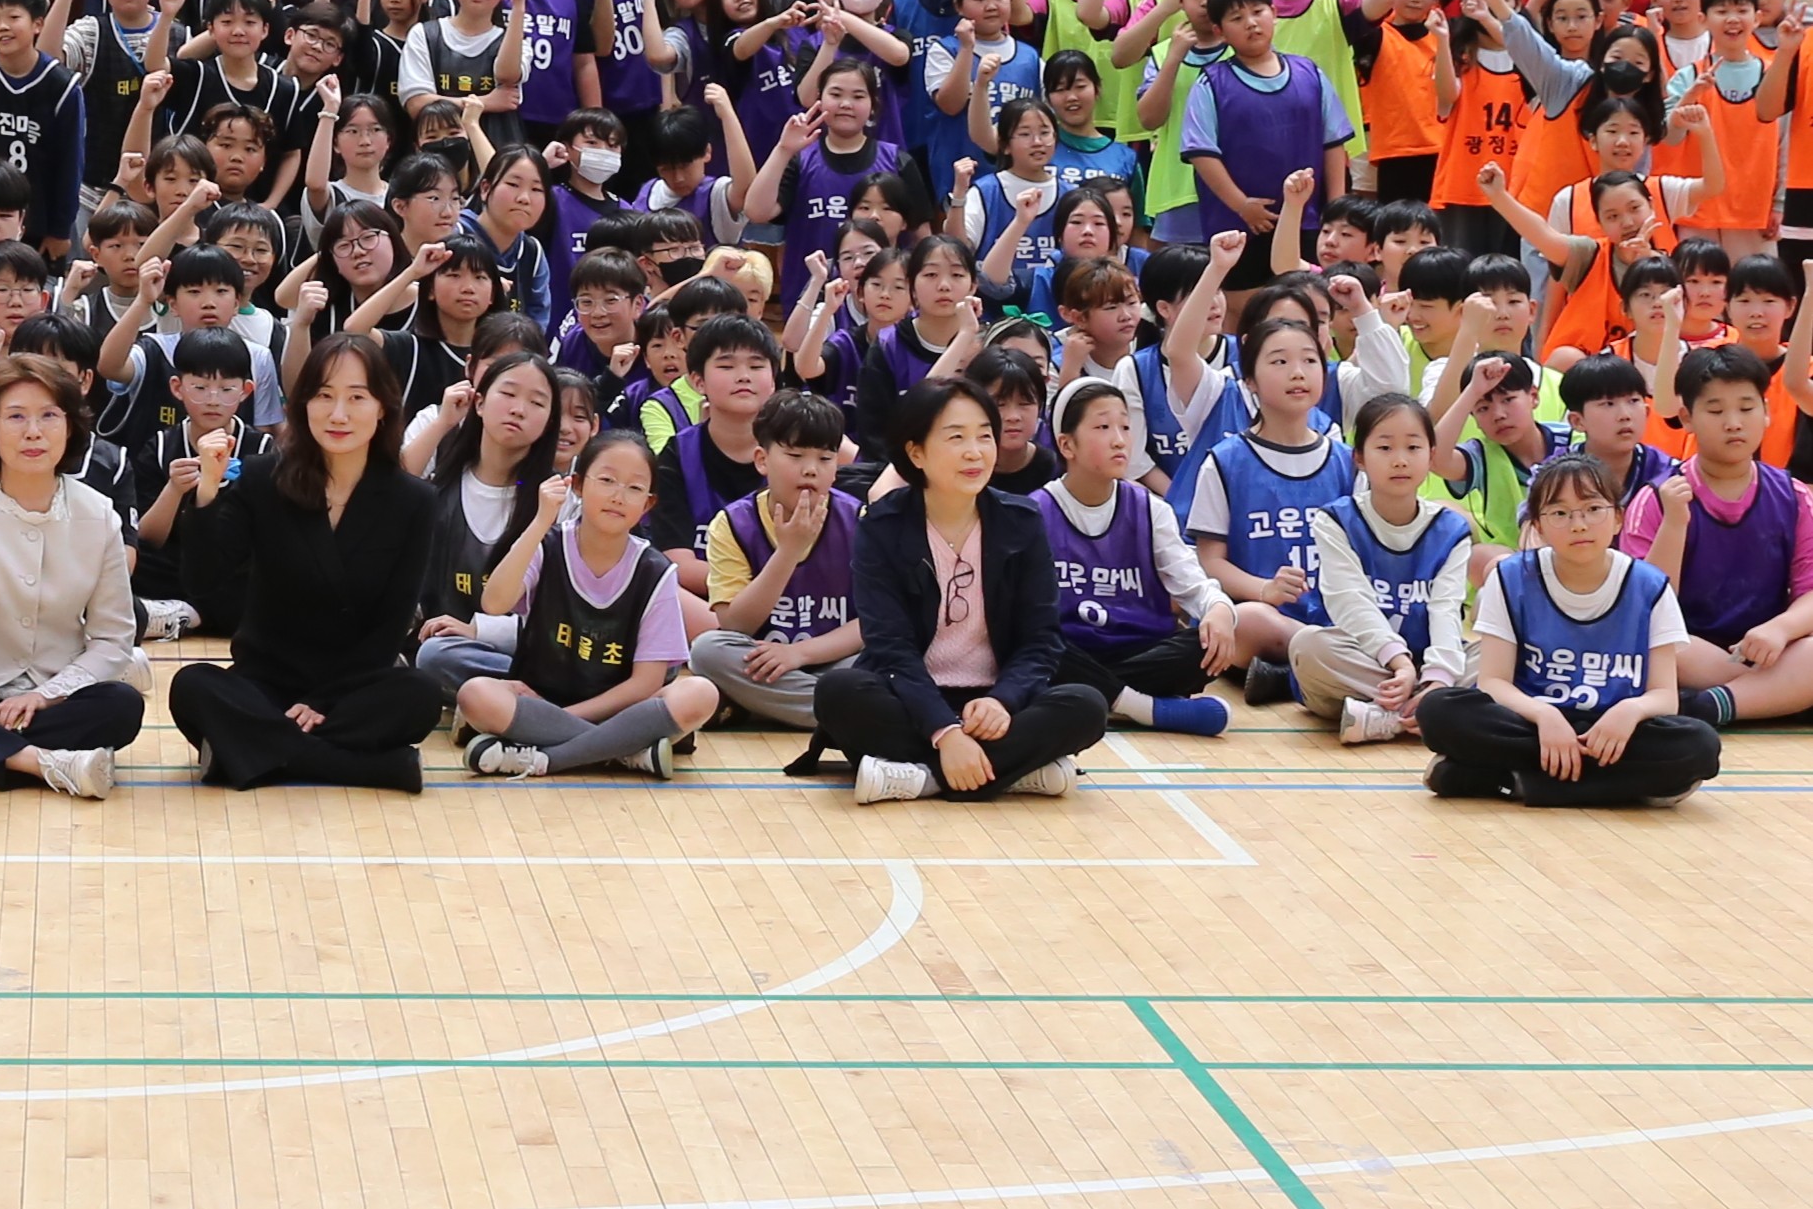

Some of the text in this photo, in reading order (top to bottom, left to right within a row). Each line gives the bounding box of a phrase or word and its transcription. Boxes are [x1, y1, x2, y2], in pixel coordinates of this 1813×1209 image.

[613, 24, 645, 61] 30
[758, 63, 795, 92] 고운
[1482, 101, 1513, 133] 14
[7, 139, 28, 174] 8
[807, 194, 849, 220] 고운
[1248, 506, 1320, 540] 고운
[770, 594, 848, 630] 운말씨
[556, 622, 624, 666] 태을초
[1523, 642, 1644, 689] 고운말씨
